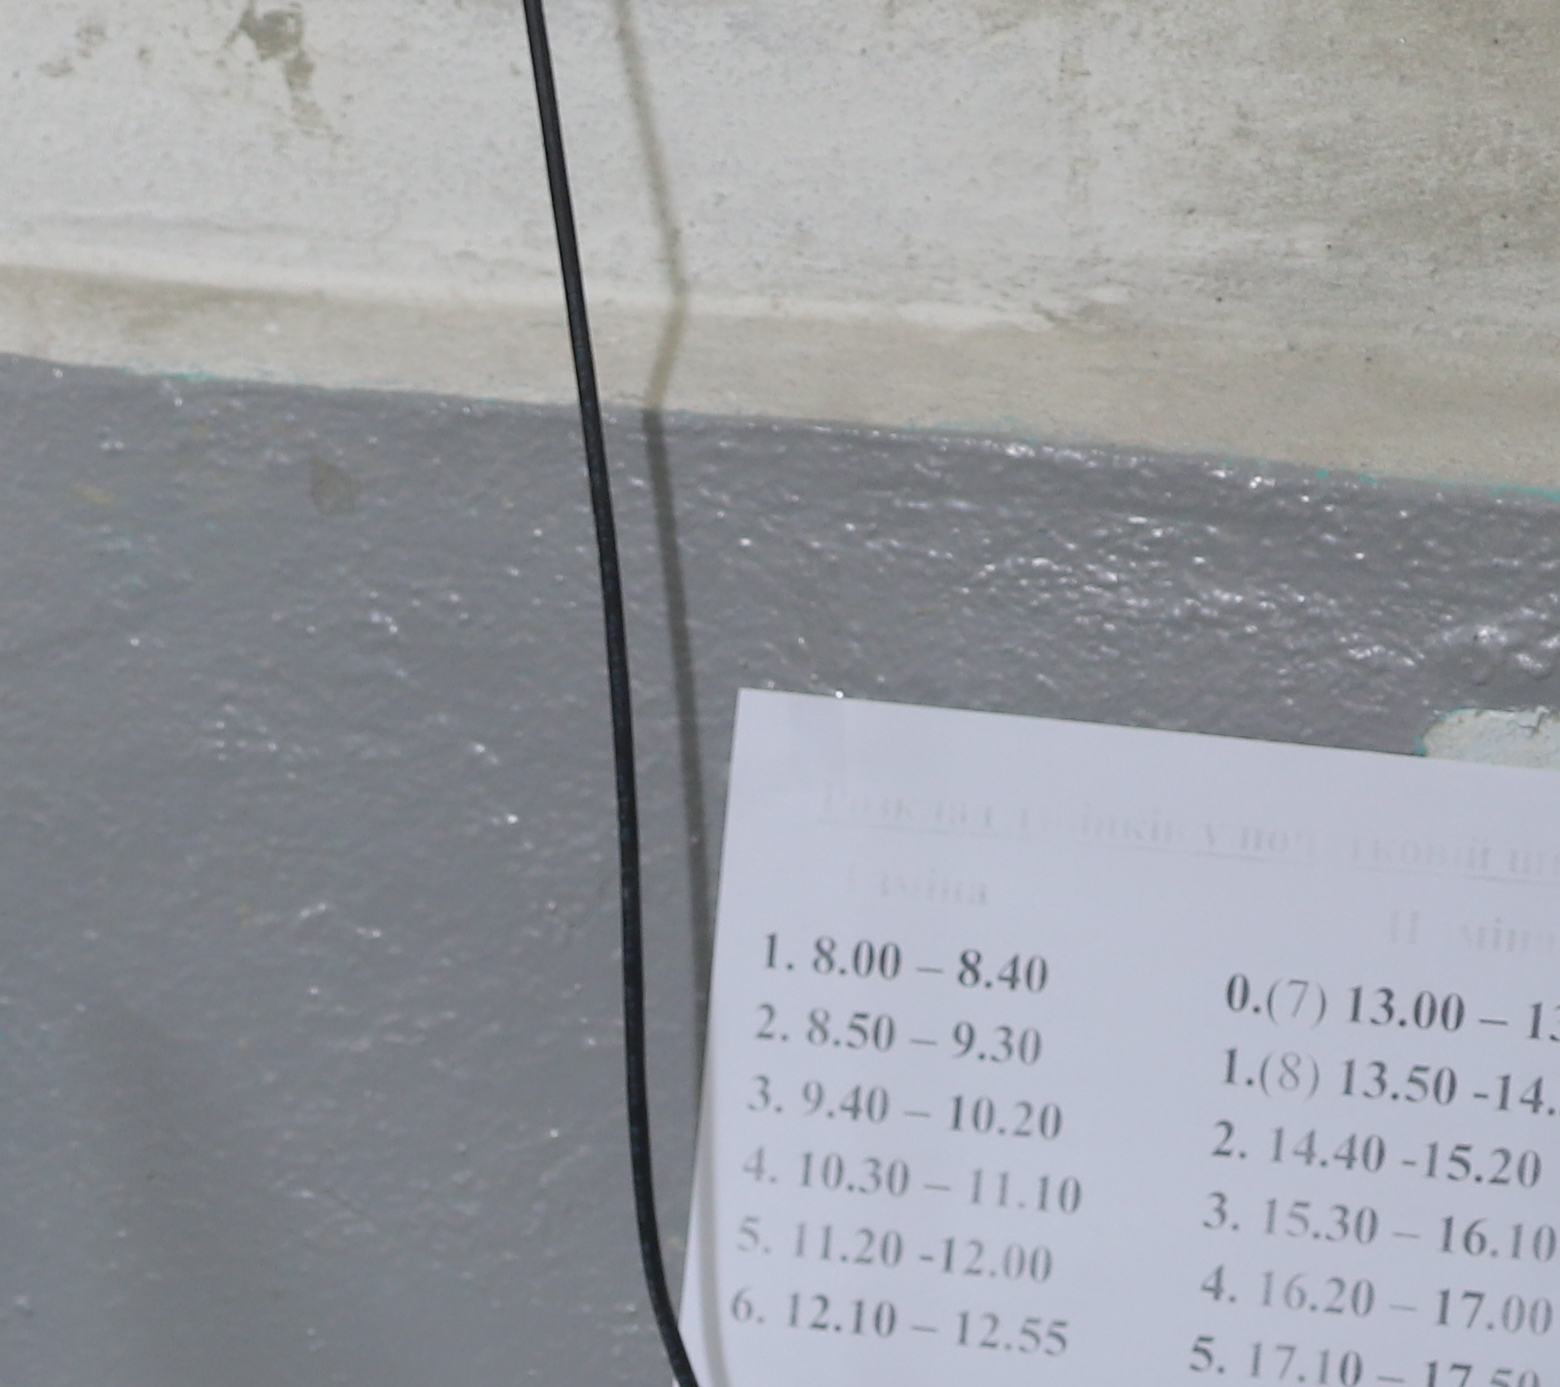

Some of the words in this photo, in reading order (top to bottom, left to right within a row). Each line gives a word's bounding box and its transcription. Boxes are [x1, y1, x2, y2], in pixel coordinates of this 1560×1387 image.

[765, 931, 795, 972] 1.
[811, 935, 903, 982] 8.00
[956, 948, 1050, 994] 8.40
[754, 1002, 790, 1043] 2.
[805, 1008, 897, 1053] 8.50
[951, 1020, 1043, 1065] 9.30
[1224, 972, 1328, 1026] 0.(7)
[1349, 984, 1466, 1033] 13.00
[747, 1074, 784, 1114] 3.
[801, 1081, 891, 1124] 9.40
[950, 1093, 1063, 1141] 10.20
[1223, 1046, 1321, 1099] 1.(8)
[1341, 1058, 1458, 1107] 13.50
[742, 1146, 777, 1184] 4.
[800, 1151, 911, 1197] 10.30
[971, 1168, 1083, 1214] 11.10
[1211, 1118, 1248, 1160] 2.
[1271, 1126, 1387, 1174] 14.40
[1401, 1141, 1543, 1189] -15.20
[738, 1215, 770, 1254] 5.
[795, 1222, 905, 1267] 11.20
[918, 1236, 1053, 1283] -12.00
[1202, 1190, 1240, 1232] 3.
[1265, 1197, 1380, 1245] 15.30
[1440, 1215, 1558, 1262] 16.10
[730, 1288, 765, 1324] 6.
[788, 1292, 898, 1339] 12.10
[957, 1310, 1069, 1357] 12.55
[1200, 1264, 1237, 1304] 4.
[1262, 1271, 1376, 1318] 16.20
[1435, 1288, 1554, 1335] 17.00
[1188, 1334, 1226, 1375] 5.
